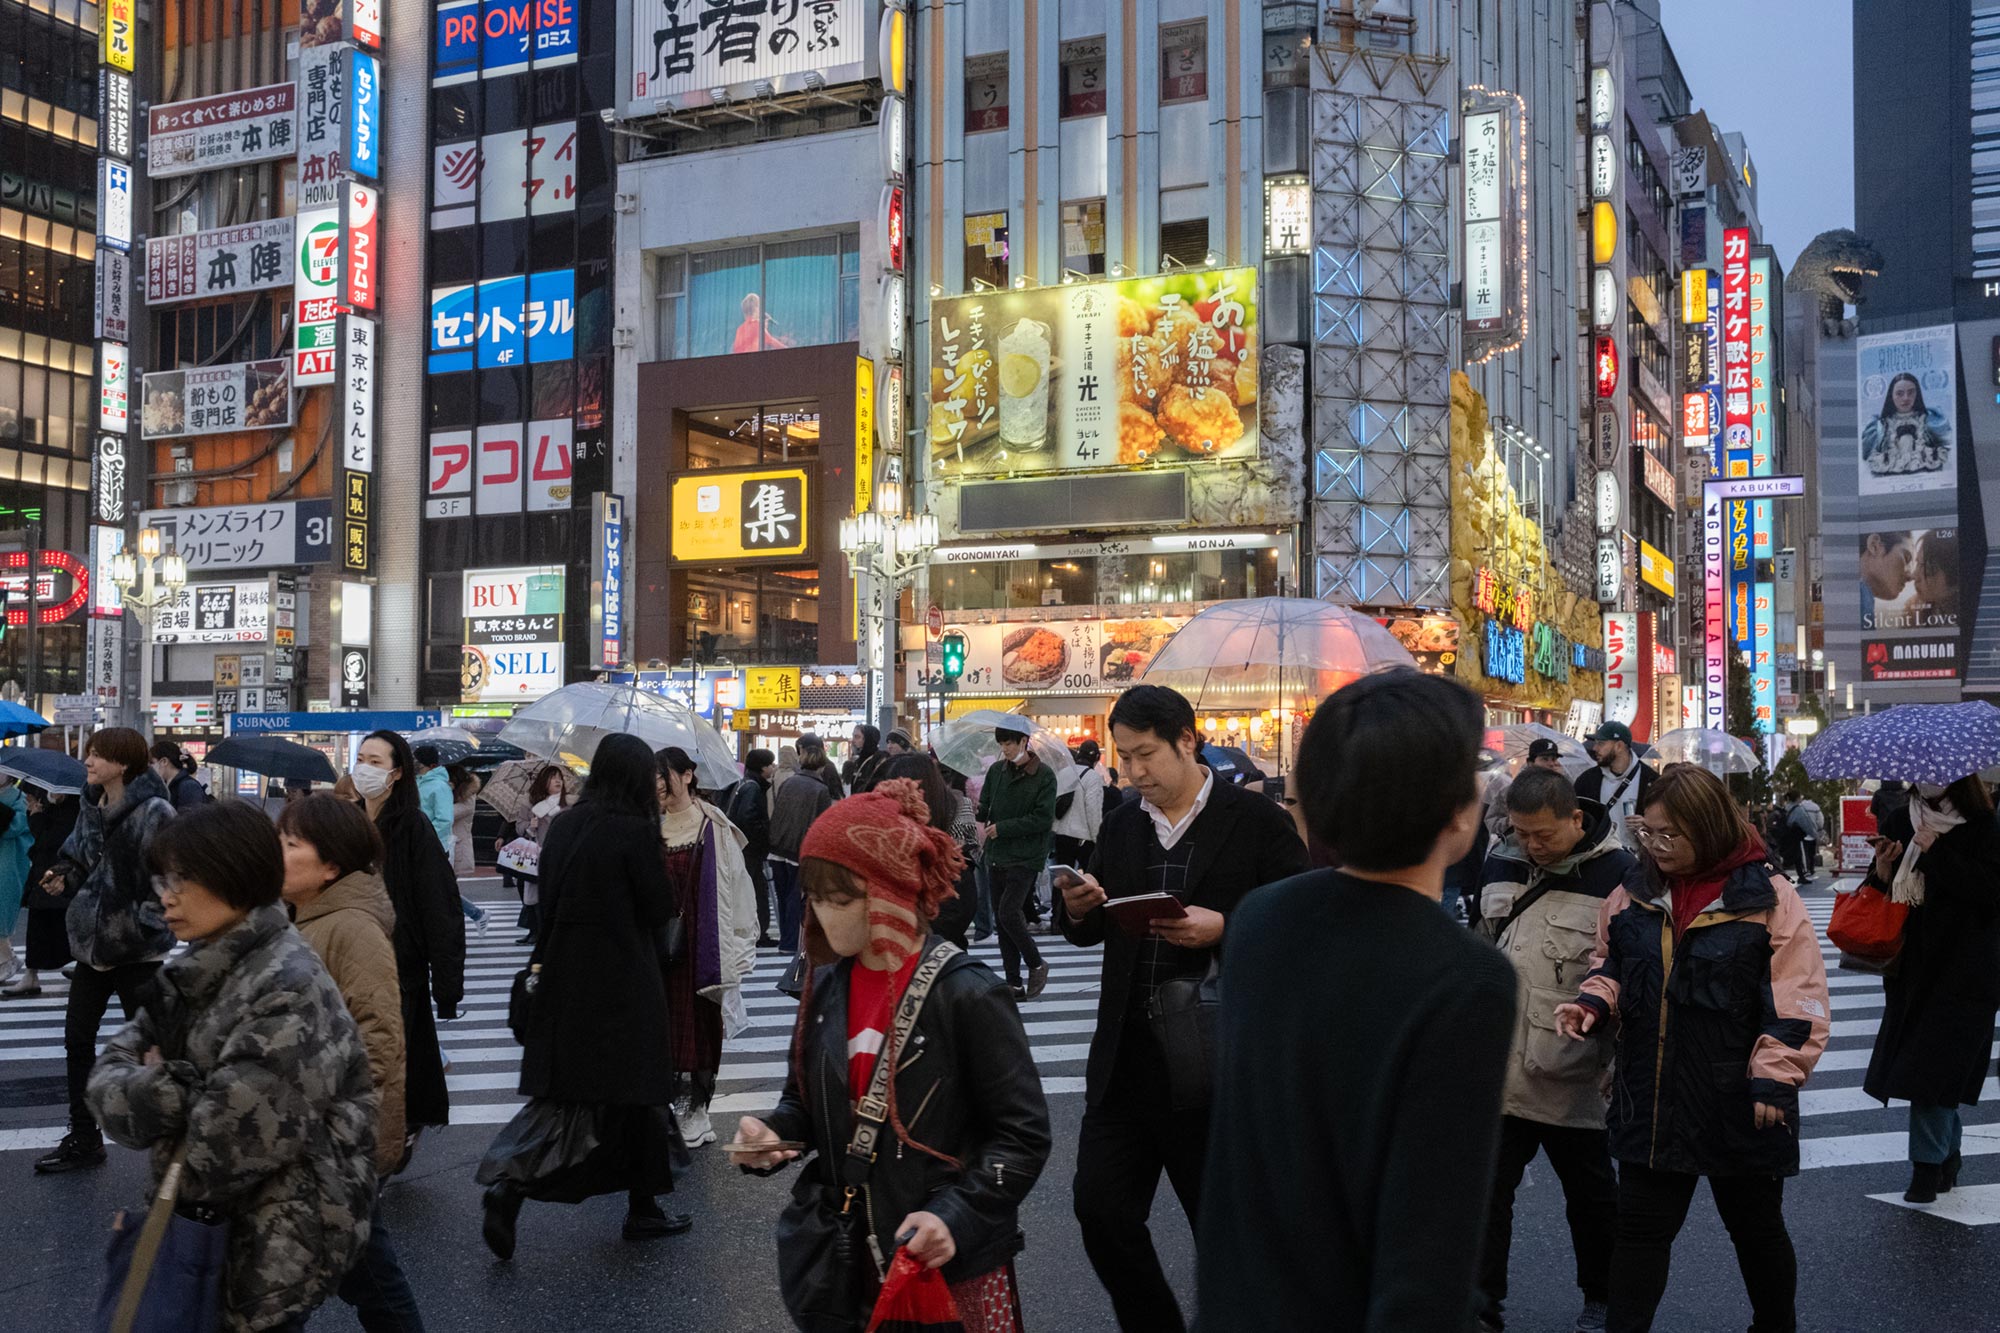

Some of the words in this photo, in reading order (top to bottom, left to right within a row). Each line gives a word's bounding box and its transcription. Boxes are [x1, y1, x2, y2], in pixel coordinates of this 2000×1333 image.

[111, 0, 128, 52] 雀ブル
[445, 0, 572, 47] PROMISE
[113, 53, 127, 65] 6F
[1268, 45, 1291, 67] や
[109, 73, 117, 100] DARTS
[1082, 67, 1098, 89] さ
[117, 75, 128, 110] BUZZ
[306, 65, 327, 143] 専門店
[983, 84, 998, 106] う
[356, 67, 373, 161] セントラル
[982, 110, 999, 129] 食
[108, 111, 117, 152] KARAOKE
[117, 111, 128, 156] STAND
[242, 118, 291, 153] 本陣
[1481, 118, 1496, 150] あー。
[1482, 150, 1496, 187] 猛烈に
[305, 182, 339, 205] HONJI
[1280, 225, 1301, 249] 光
[207, 241, 283, 290] 本陣
[353, 230, 370, 290] アコム
[111, 258, 123, 317] お好み焼き
[354, 290, 368, 303] 3F
[1476, 288, 1491, 305] 光
[105, 317, 127, 331] 本陣
[433, 298, 574, 348] セントラル
[1158, 293, 1182, 371] チキンが
[1207, 279, 1248, 362] あー。
[1478, 320, 1491, 329] 4F
[1725, 235, 1749, 416] カラオケ歌広場
[314, 327, 336, 346] 酒
[1083, 322, 1093, 371] チキン酒場
[301, 350, 335, 374] AT
[497, 349, 514, 364] 4F
[967, 305, 995, 430] チキンにぴったり!
[1130, 332, 1157, 400] たべたい。
[1186, 330, 1218, 401] 猛烈に
[190, 384, 236, 407] 粉もの
[940, 316, 968, 463] レモンサワー
[1077, 375, 1099, 402] 光
[190, 406, 237, 428] 専門店
[1750, 272, 1768, 546] カラオケ&パーテー館
[1076, 429, 1100, 440] 当ビル
[431, 435, 572, 491] アコム
[1076, 441, 1100, 461] 4F
[349, 477, 365, 513] 買取
[1730, 482, 1791, 494] KABUKI町
[439, 500, 461, 515] 3F
[743, 483, 797, 544] 集
[181, 509, 286, 536] メンズライフ
[183, 538, 265, 566] クリニック
[349, 527, 364, 565] 販売
[947, 549, 1020, 561] OKONOMIYAKI
[1187, 538, 1235, 550] MONJA
[472, 583, 523, 607] BUY
[1601, 590, 1614, 598] B1
[1707, 521, 1721, 643] GODZILLA
[158, 610, 190, 629] 酒場
[1863, 611, 1913, 629] Silent
[1915, 610, 1958, 627] Love
[202, 633, 233, 642] ビール
[235, 631, 263, 641] 190
[491, 634, 514, 642] TOKYO
[514, 633, 537, 641] BRAND
[1070, 625, 1082, 649] そば
[1083, 624, 1096, 670] かき揚げ
[103, 625, 114, 684] お好み焼き
[493, 651, 557, 675] SELL
[1443, 654, 1454, 664] 2F
[1607, 620, 1624, 689] トラノコ
[1754, 596, 1771, 720] カラオケ館
[1893, 643, 1955, 660] MARUHAN
[774, 673, 797, 704] 集
[1063, 673, 1099, 688] 600円
[1708, 658, 1722, 716] ROAD
[236, 716, 291, 730] SUBNADE
